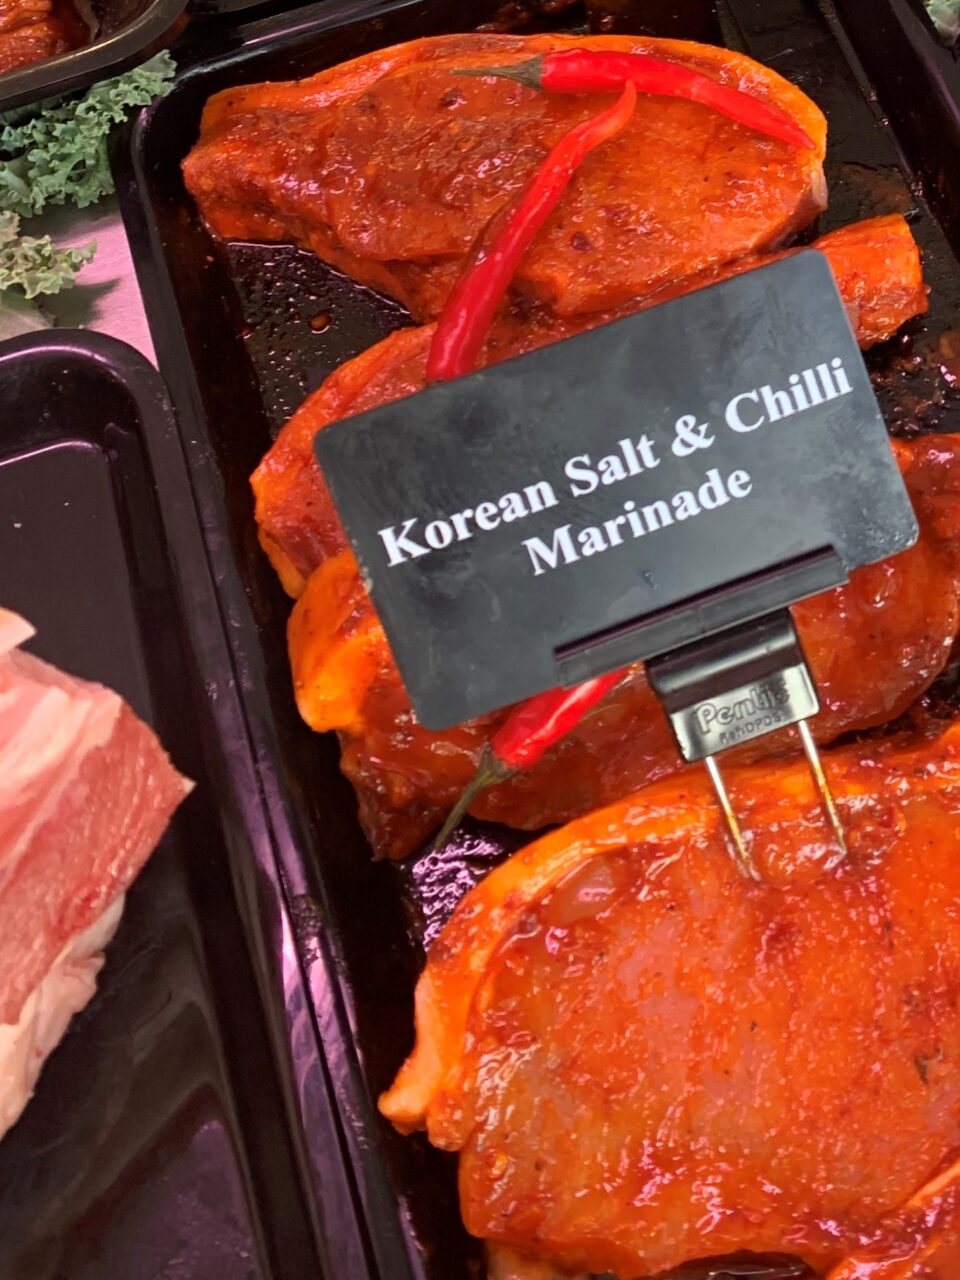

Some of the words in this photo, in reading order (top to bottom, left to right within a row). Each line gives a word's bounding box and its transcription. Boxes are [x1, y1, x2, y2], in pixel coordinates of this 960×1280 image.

[378, 480, 559, 568] Korean
[563, 434, 661, 498] Salt
[670, 413, 716, 458] &
[725, 356, 853, 434] Chilli
[521, 468, 754, 576] Marinade
